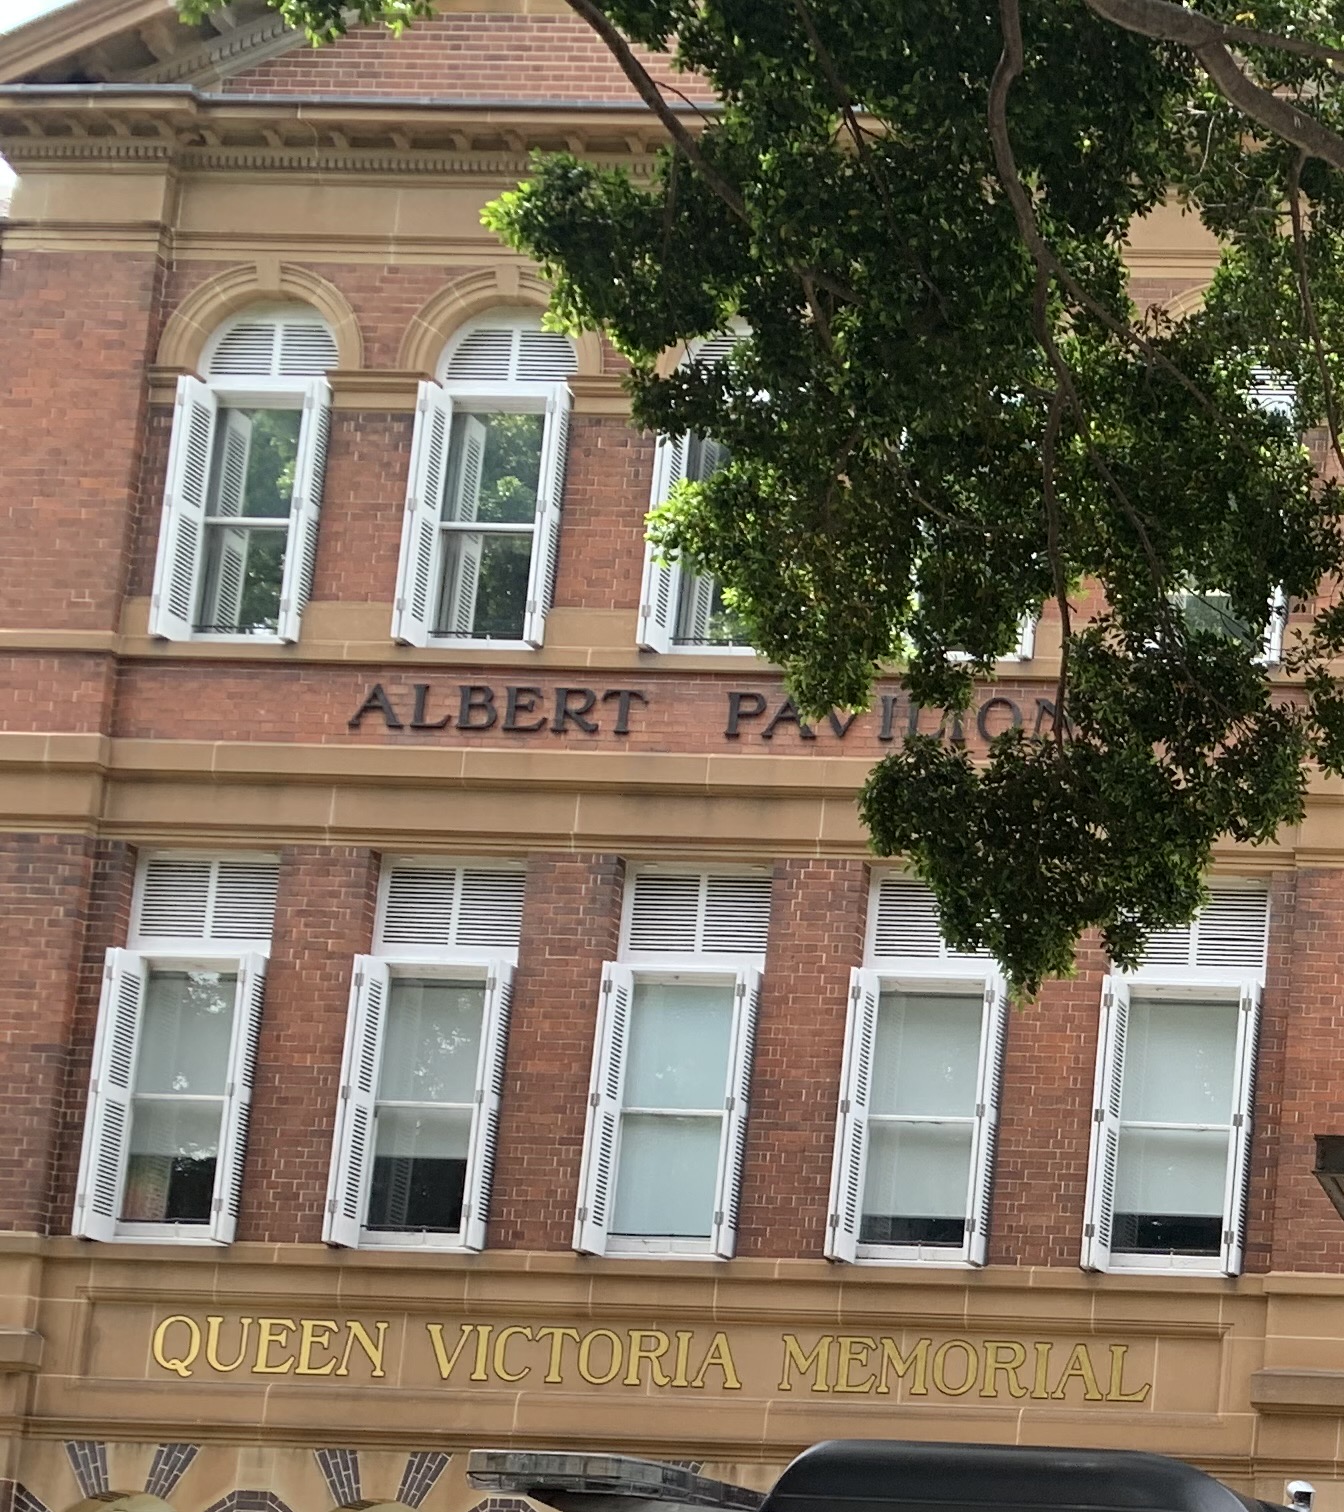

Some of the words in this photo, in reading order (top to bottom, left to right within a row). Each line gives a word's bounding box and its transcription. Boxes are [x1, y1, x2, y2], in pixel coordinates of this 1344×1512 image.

[347, 682, 649, 734] ALBERT
[152, 1314, 390, 1377] QUEEN
[426, 1322, 743, 1390] VICTORIA
[779, 1334, 1153, 1402] MEMORIAL
